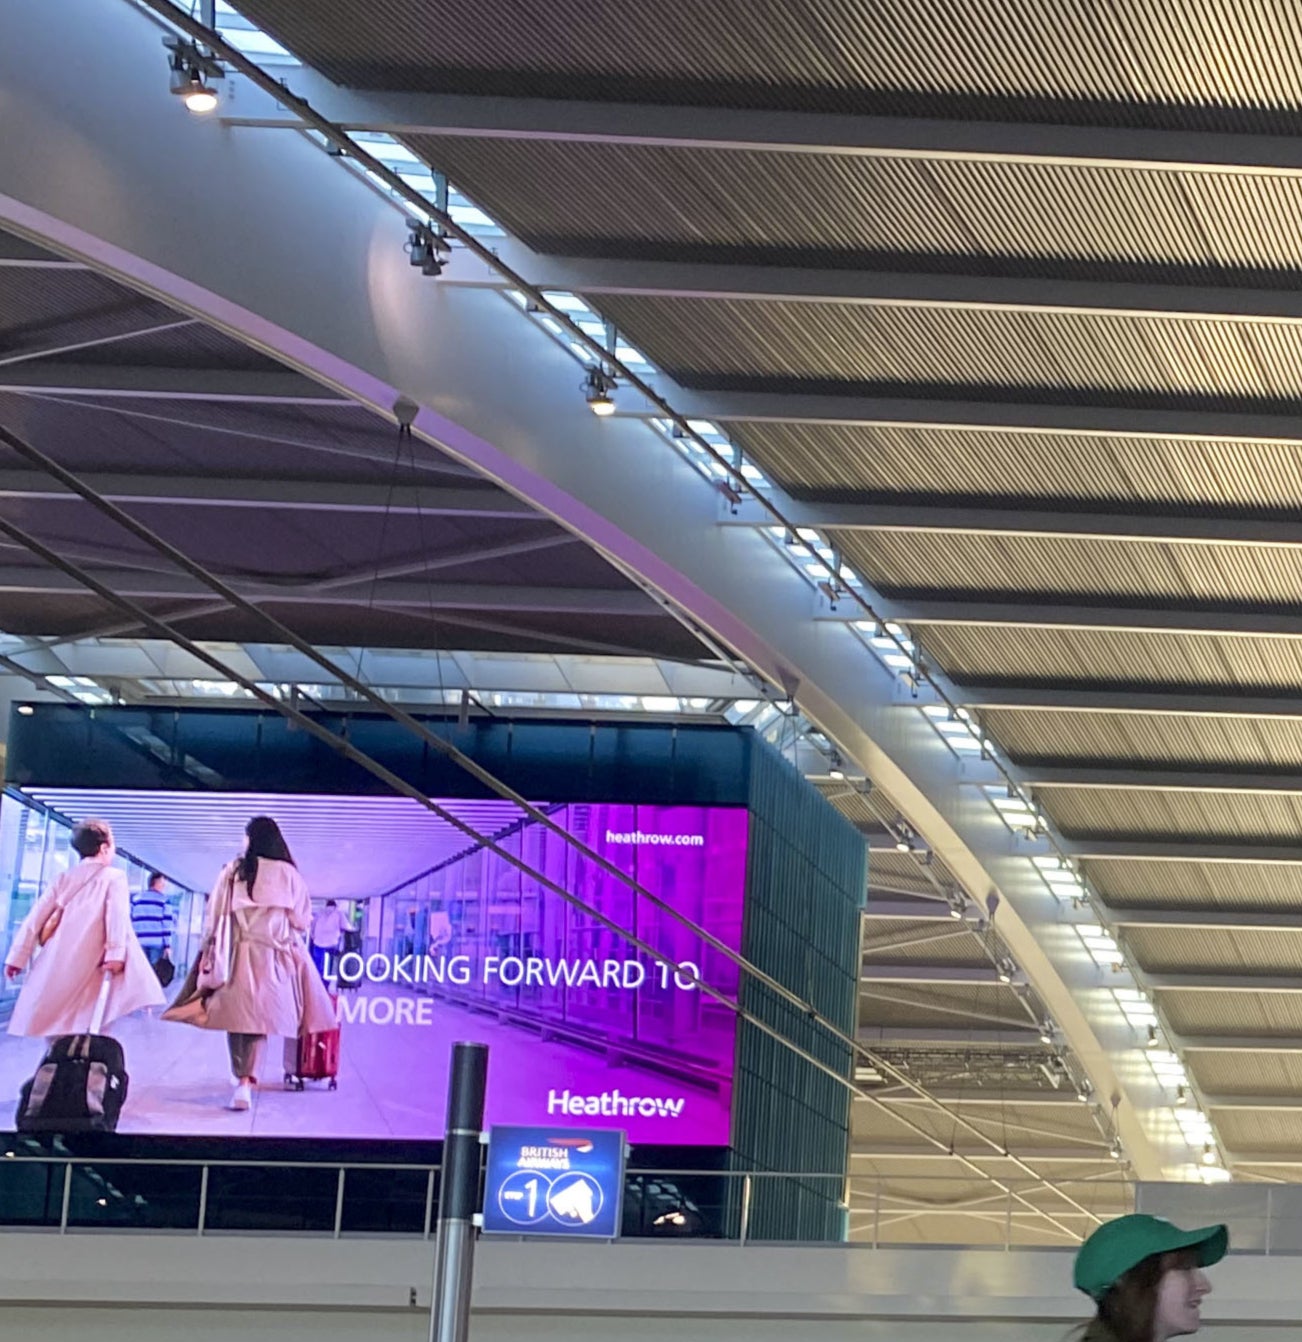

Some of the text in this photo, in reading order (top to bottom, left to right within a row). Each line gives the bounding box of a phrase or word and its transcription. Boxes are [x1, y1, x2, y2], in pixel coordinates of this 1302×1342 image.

[606, 829, 704, 846] heathrow.com
[323, 953, 700, 990] LOOKING FORWARD TO
[337, 997, 434, 1025] MORE
[547, 1090, 685, 1117] Heathrow
[521, 1146, 569, 1159] BRITISH
